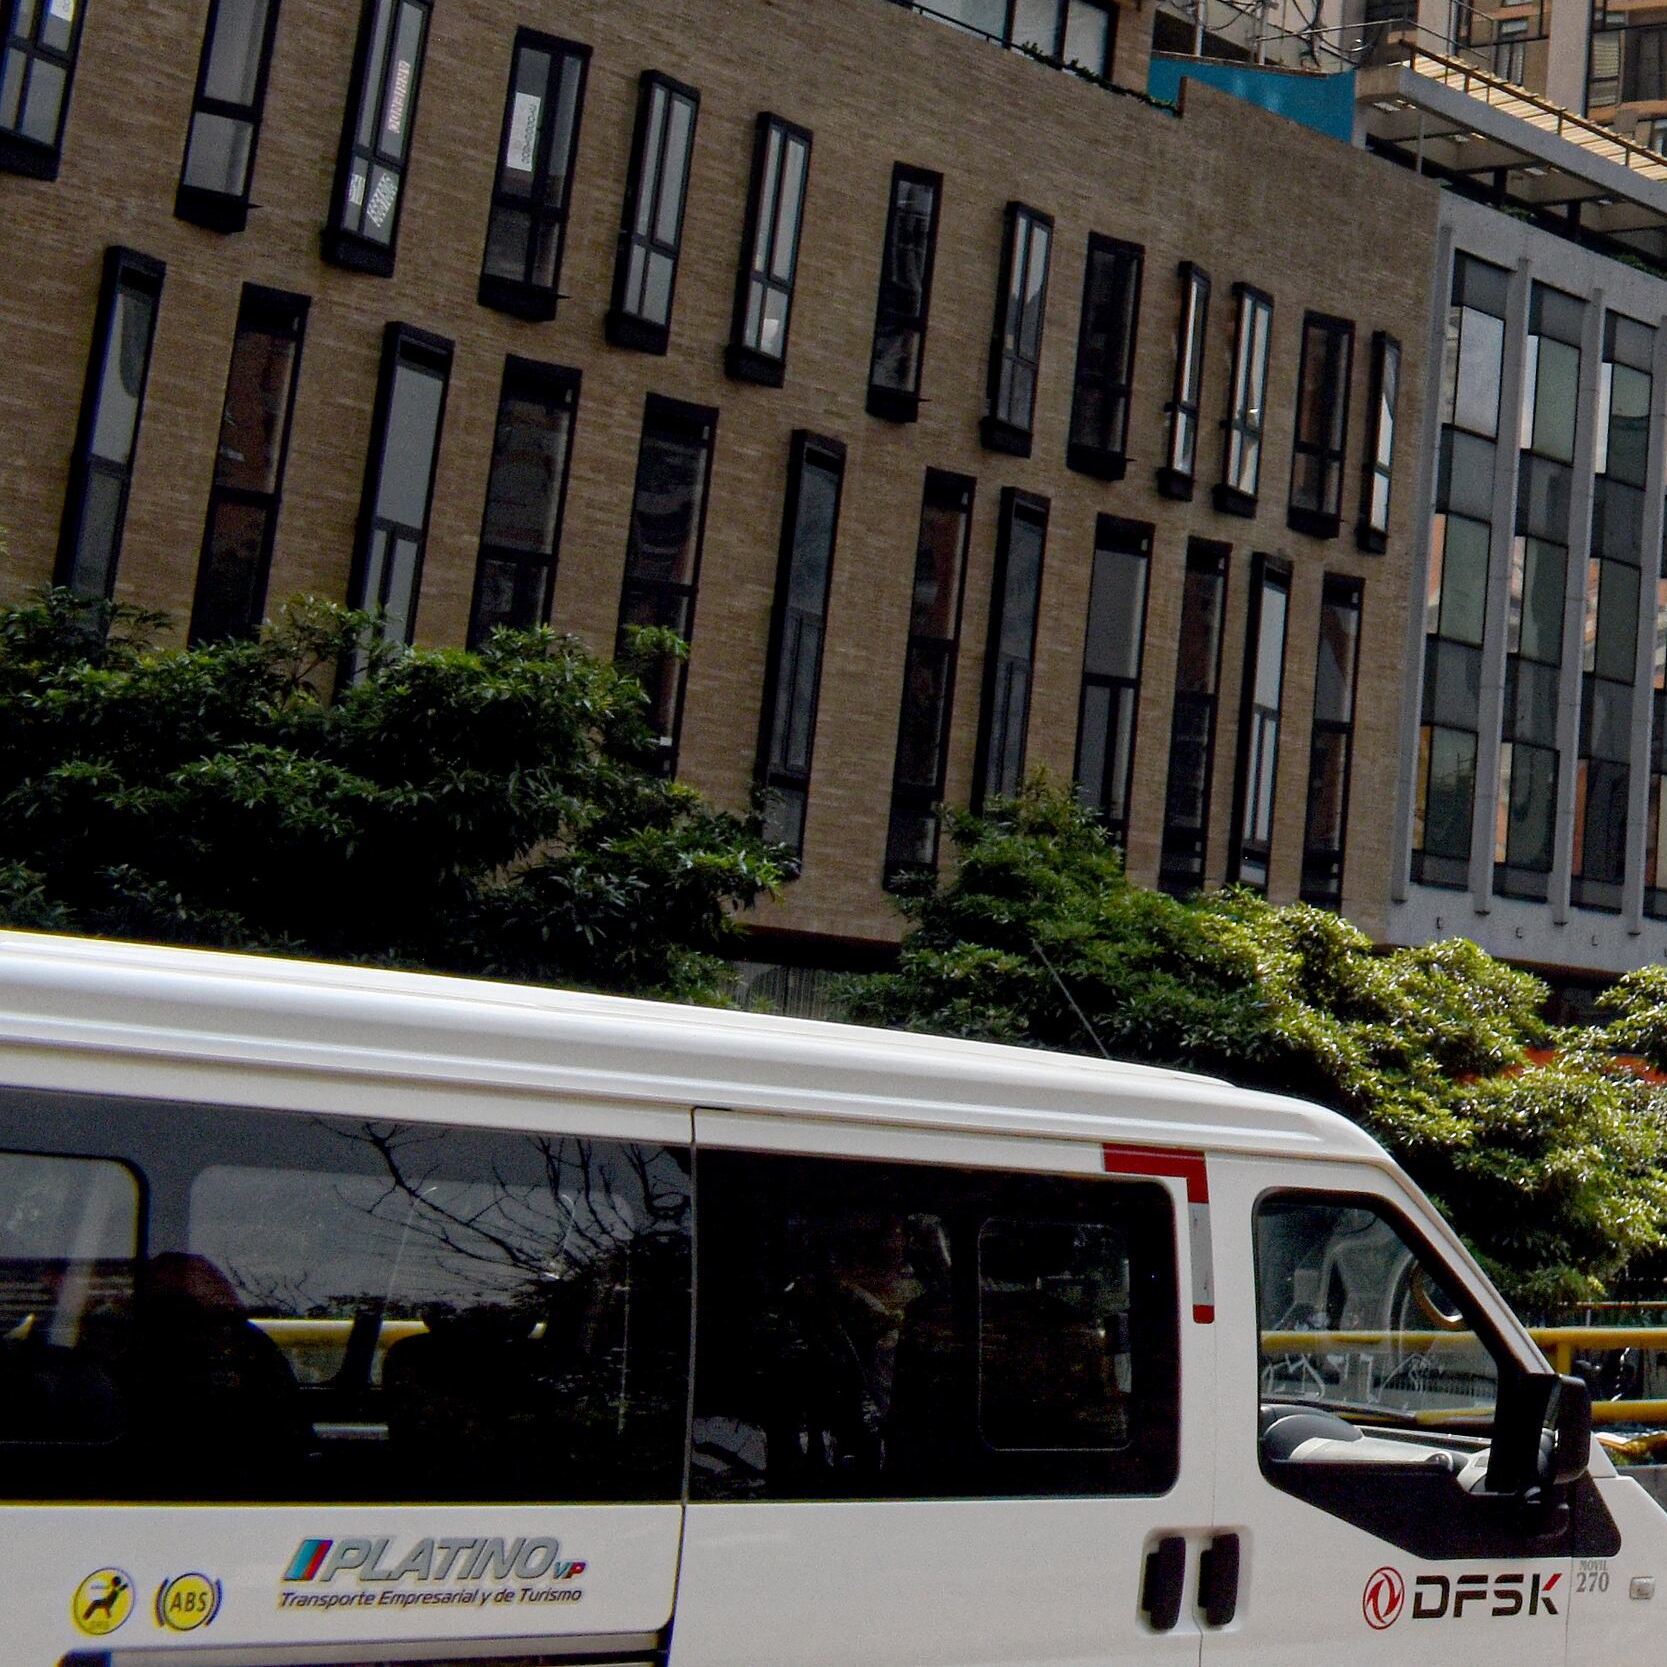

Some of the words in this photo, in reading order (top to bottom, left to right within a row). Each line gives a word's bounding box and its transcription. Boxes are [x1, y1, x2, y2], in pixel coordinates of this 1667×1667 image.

[320, 1537, 559, 1582] PLATINO
[1576, 1571, 1609, 1593] 270
[169, 1591, 208, 1612] ABS
[281, 1590, 375, 1609] Transporte
[378, 1587, 479, 1608] Empresarial
[480, 1591, 493, 1607] y
[495, 1587, 515, 1602] de
[519, 1586, 583, 1603] Turismo
[1412, 1572, 1563, 1619] DFSK
